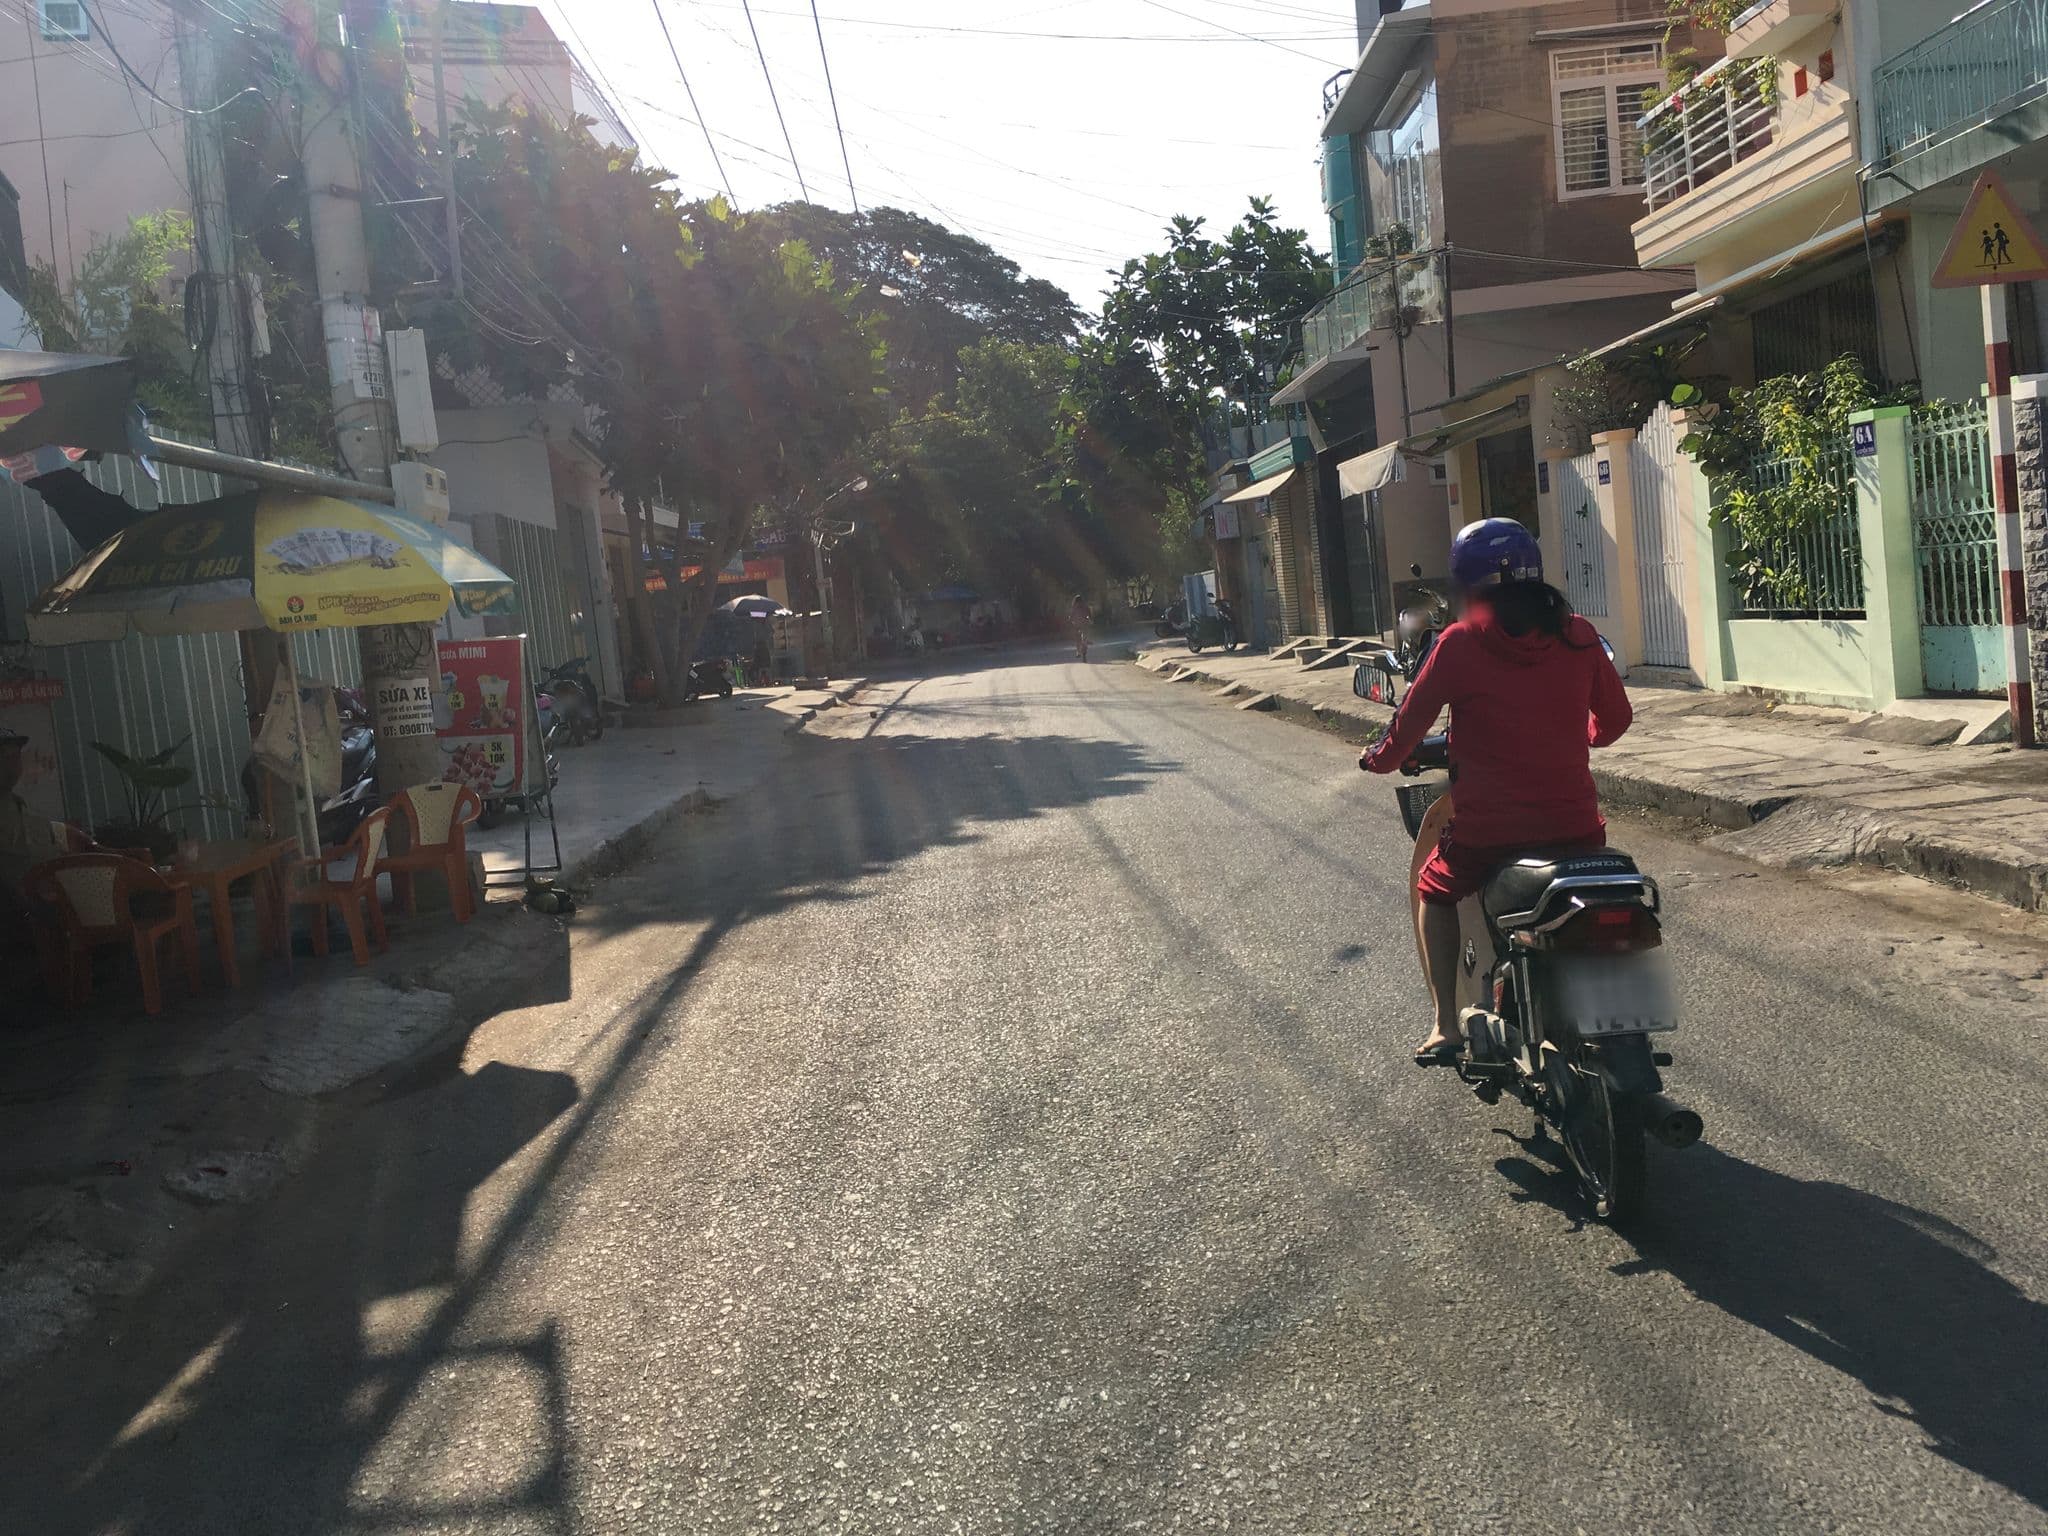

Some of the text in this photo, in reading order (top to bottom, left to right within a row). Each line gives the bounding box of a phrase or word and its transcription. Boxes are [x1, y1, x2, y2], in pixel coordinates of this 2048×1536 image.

[1856, 425, 1873, 444] 6A
[458, 646, 487, 659] MIMI
[413, 686, 428, 700] XE
[491, 742, 503, 752] 5K
[489, 753, 505, 764] 10K
[1567, 859, 1626, 871] HONDA
